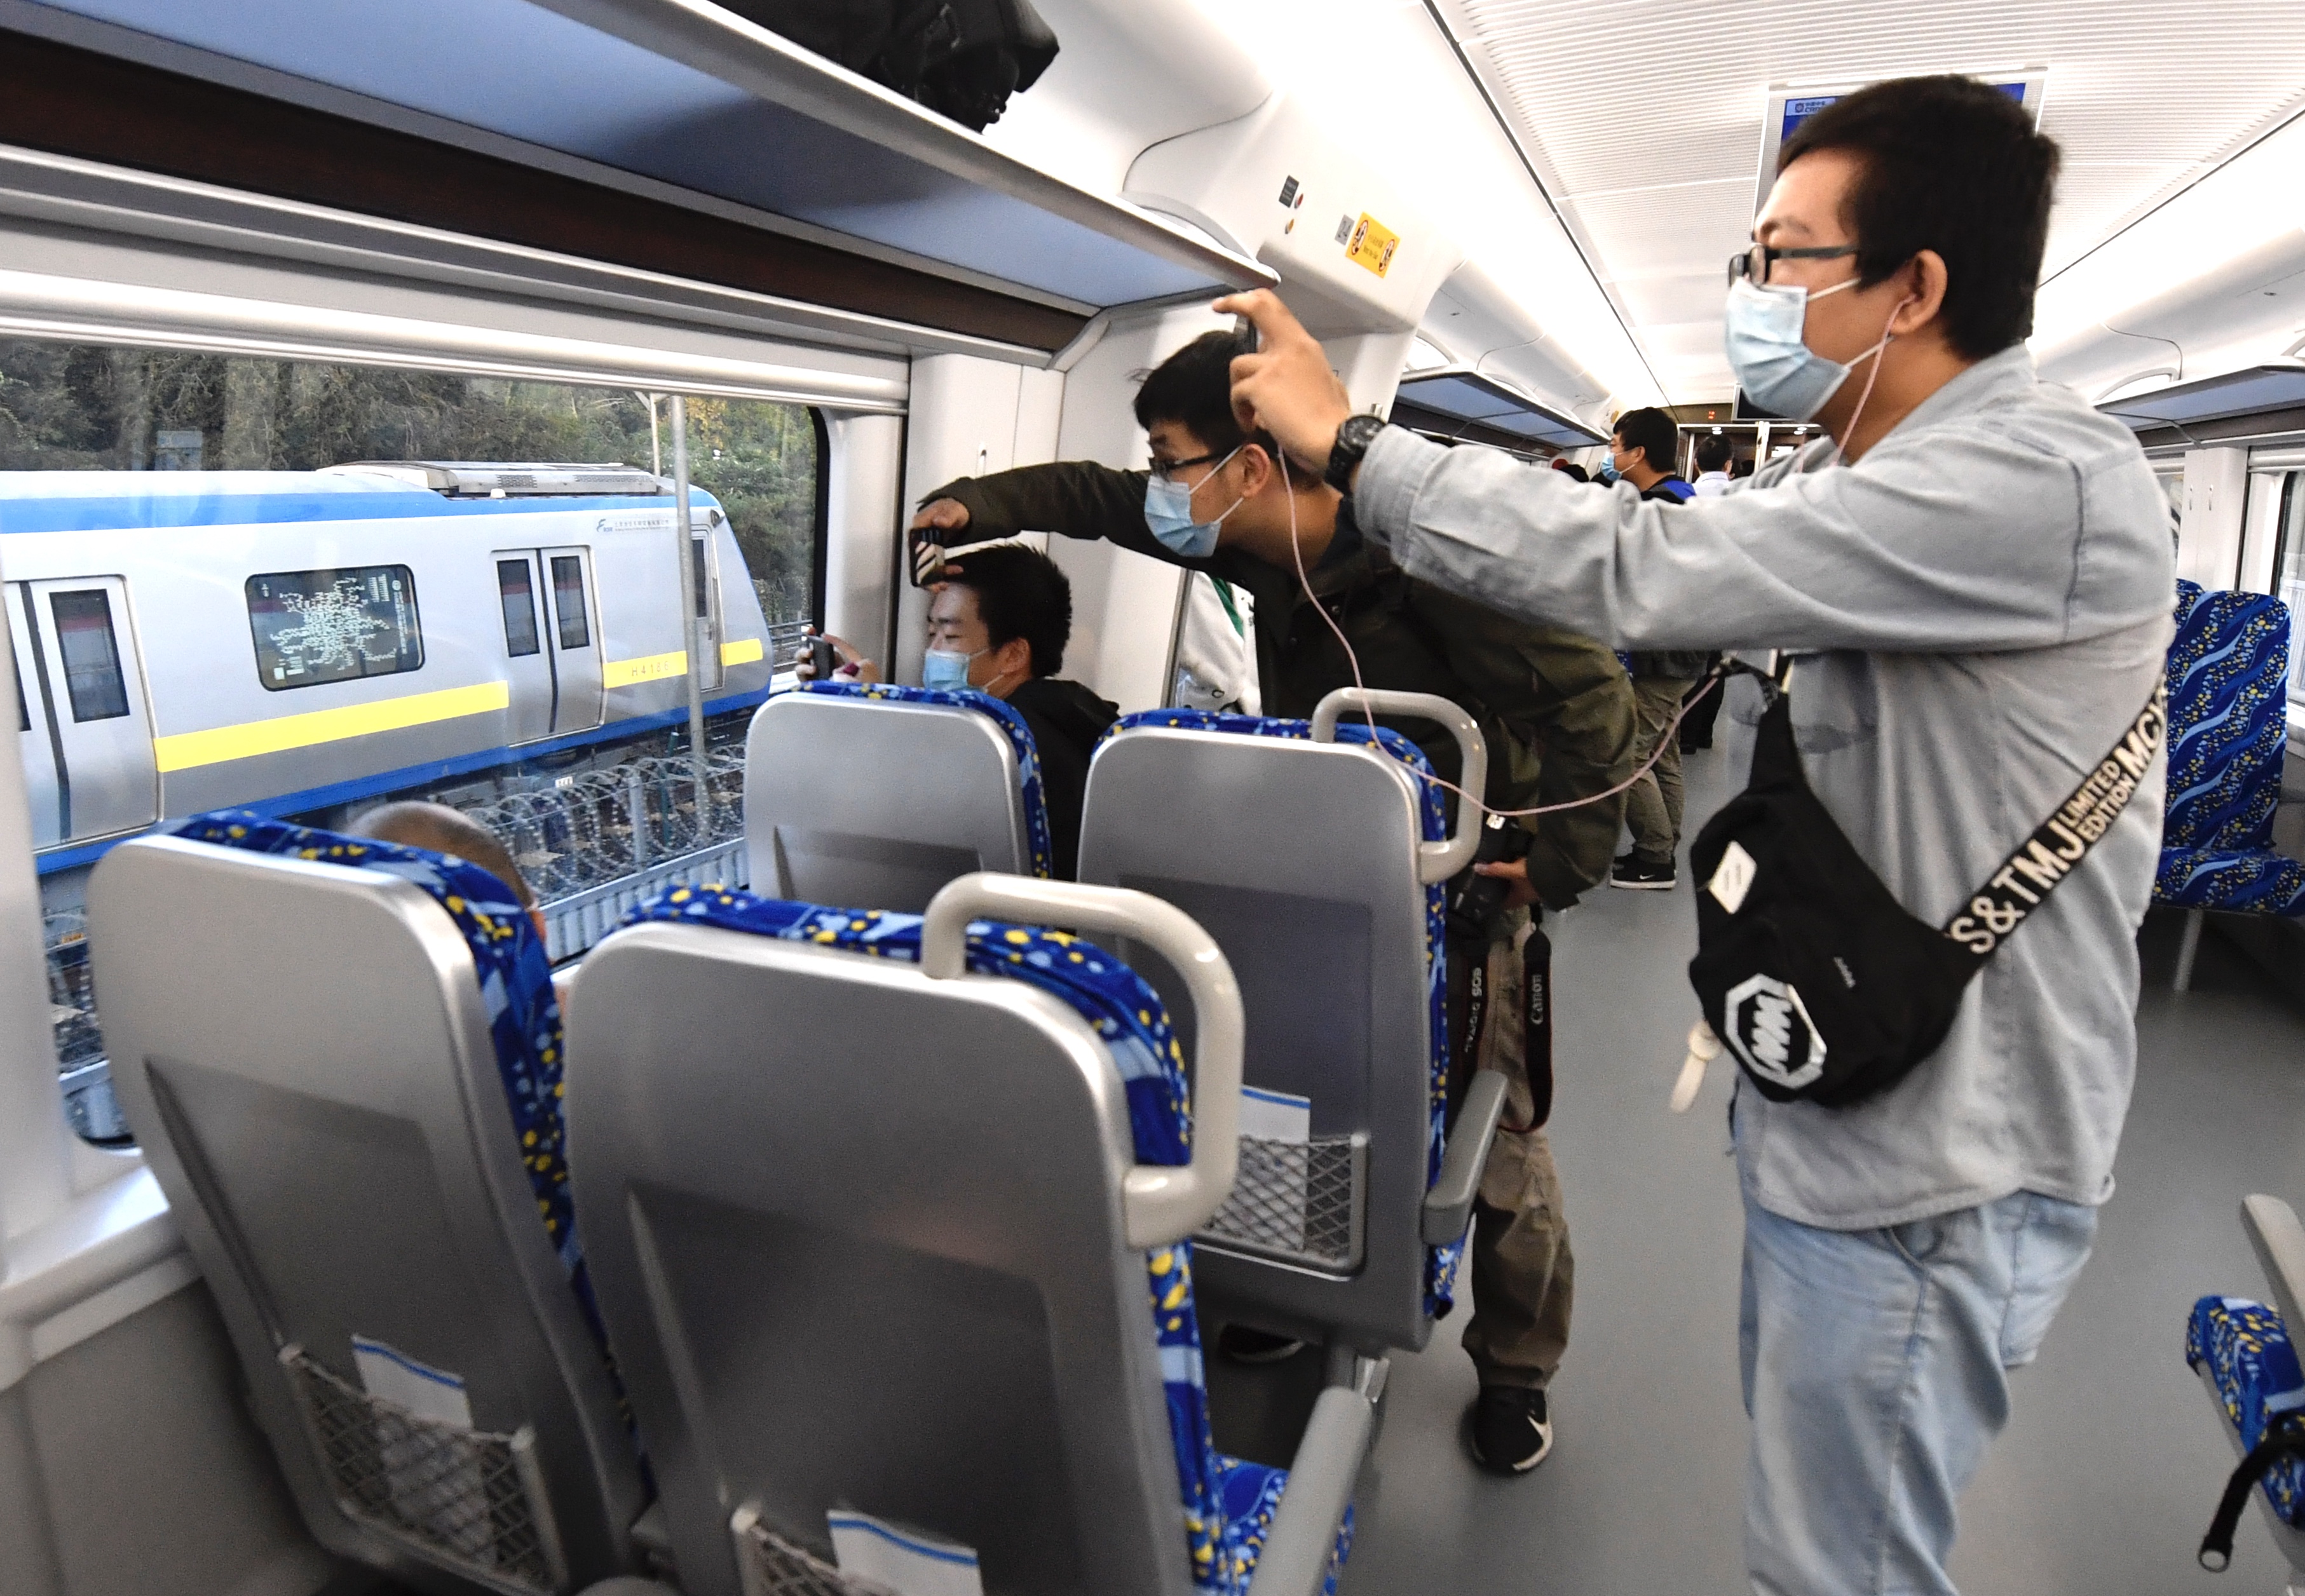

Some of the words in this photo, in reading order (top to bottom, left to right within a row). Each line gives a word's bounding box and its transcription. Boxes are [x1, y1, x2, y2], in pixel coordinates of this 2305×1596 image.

[2056, 760, 2120, 828] LIMITED
[2075, 773, 2137, 842] EDITION
[1950, 820, 2084, 954] S&TMJ
[1471, 967, 1482, 997] EOS
[1530, 973, 1544, 1025] Canon
